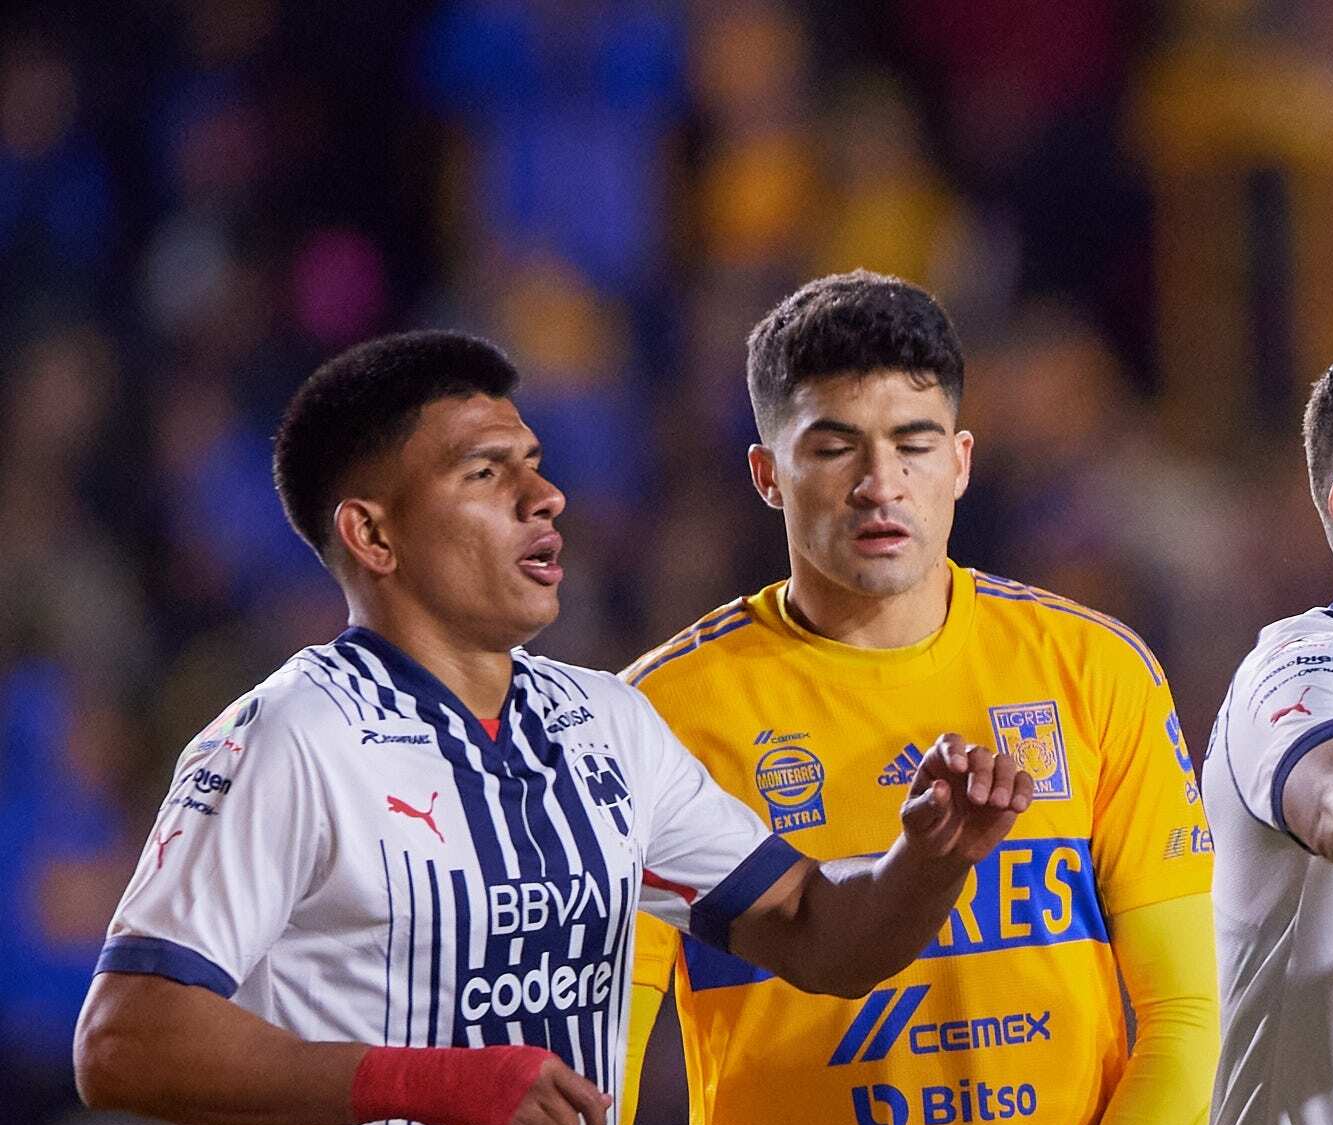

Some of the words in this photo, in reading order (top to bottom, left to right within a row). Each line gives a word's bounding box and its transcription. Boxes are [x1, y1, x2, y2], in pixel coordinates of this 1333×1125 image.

[1000, 710, 1053, 728] TIGRES
[757, 764, 821, 790] MONTERREY
[1034, 781, 1054, 793] ANL
[775, 809, 822, 830] EXTRA
[489, 871, 608, 935] BBVA
[460, 952, 613, 1022] codere
